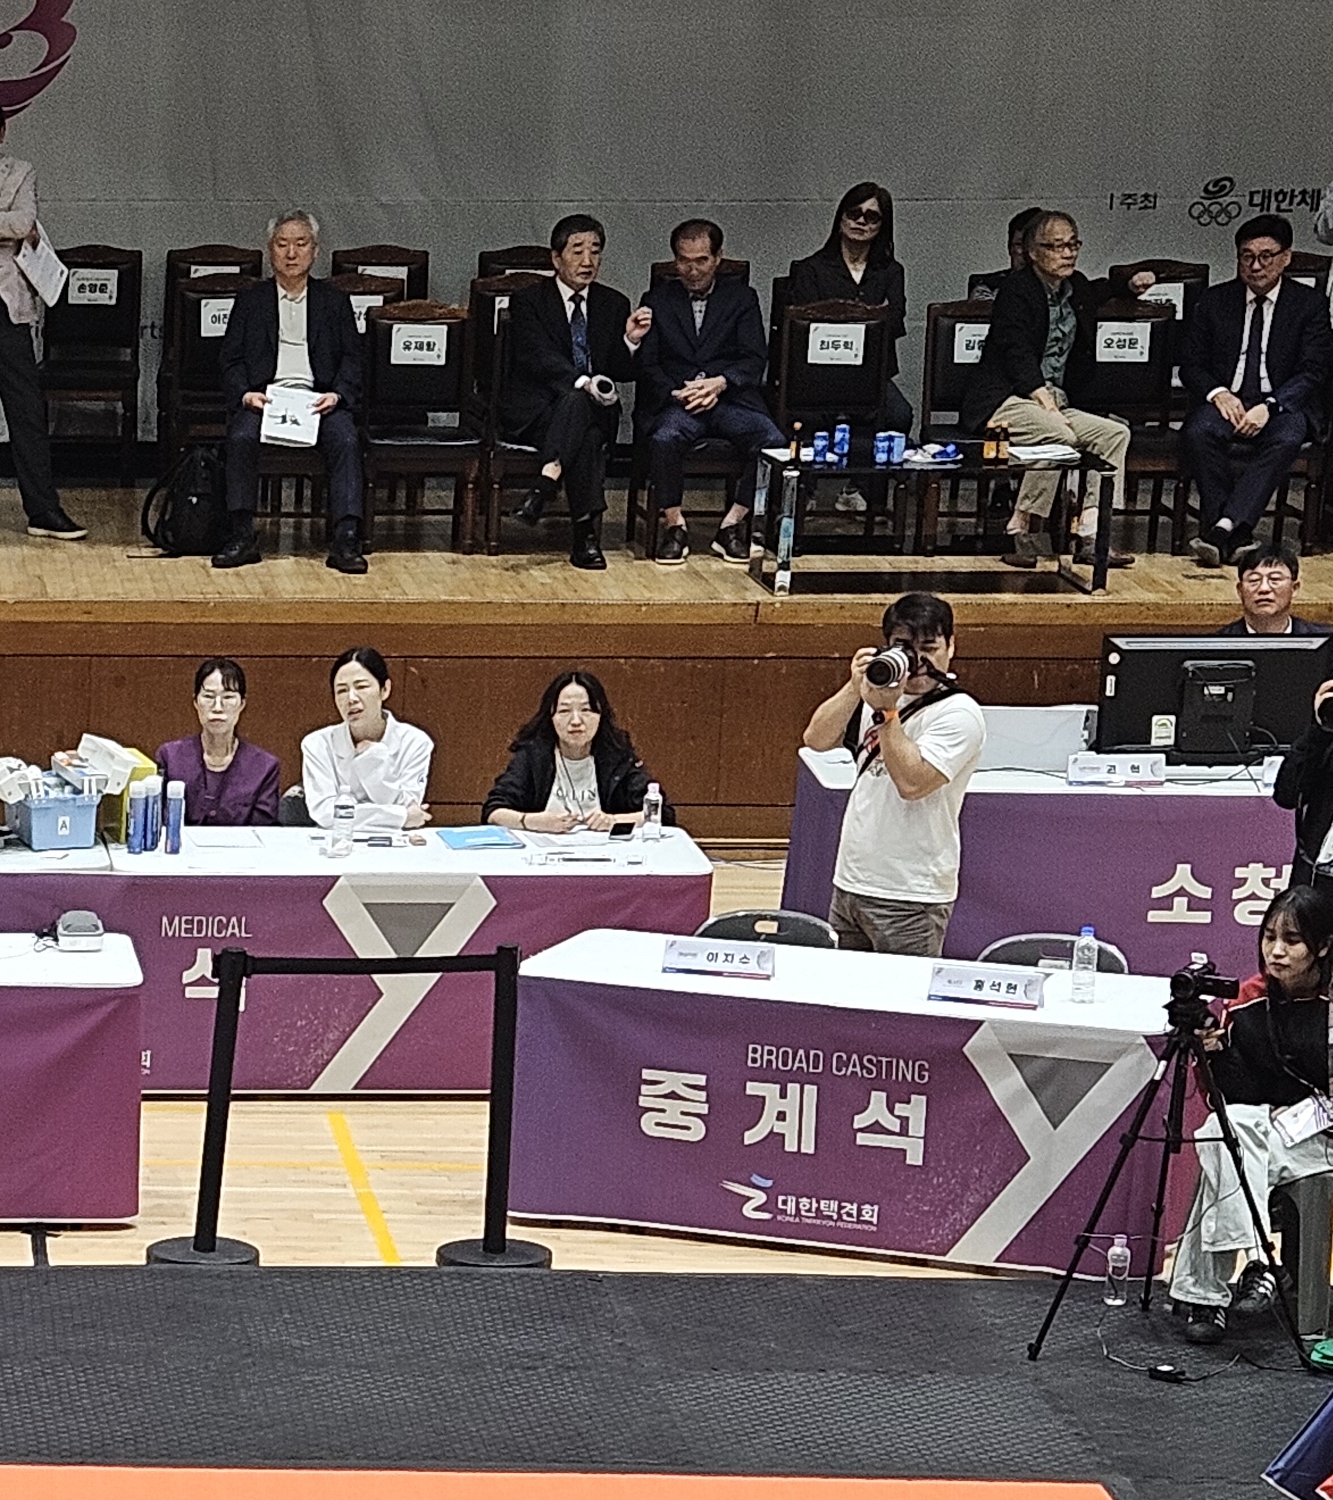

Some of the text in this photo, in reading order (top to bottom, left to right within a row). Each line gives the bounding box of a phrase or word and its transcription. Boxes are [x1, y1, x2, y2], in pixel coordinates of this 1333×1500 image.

[1248, 188, 1322, 213] 대한체
[59, 820, 68, 831] A
[160, 915, 253, 938] MEDICAL
[746, 1043, 930, 1084] BROAD CASTING
[777, 1195, 880, 1225] 대한택견회
